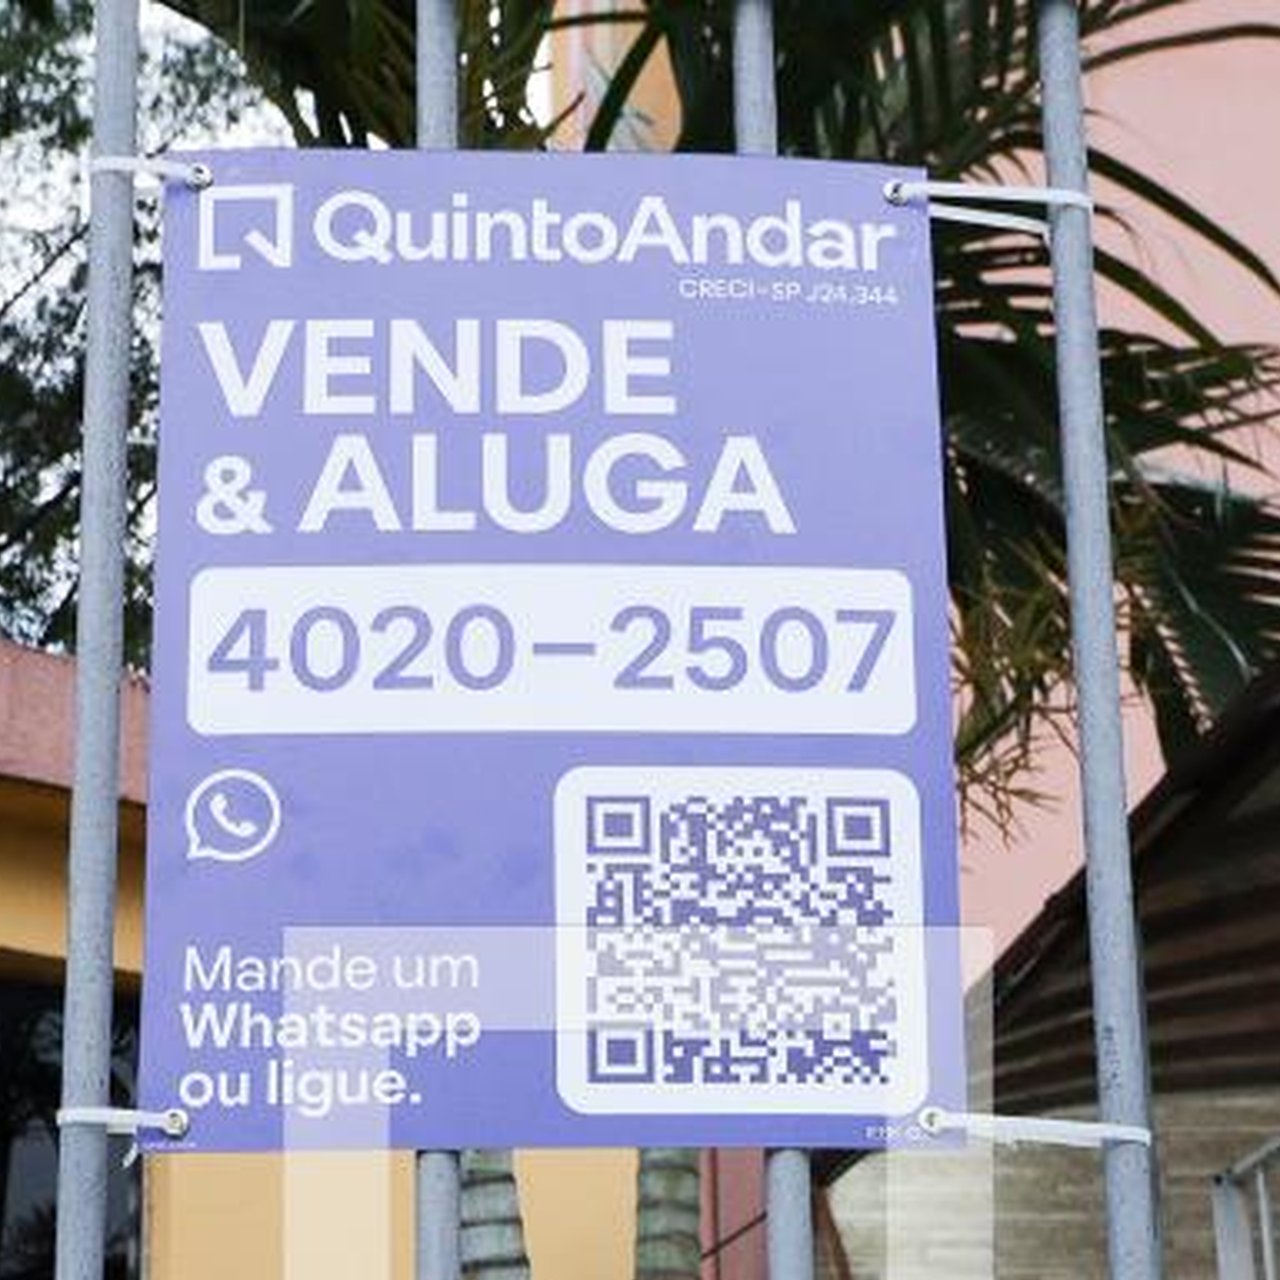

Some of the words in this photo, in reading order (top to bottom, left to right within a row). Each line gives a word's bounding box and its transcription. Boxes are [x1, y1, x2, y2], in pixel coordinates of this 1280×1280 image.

[313, 190, 898, 271] QuintoAndar
[198, 319, 678, 417] VENDE
[195, 455, 273, 535] &
[296, 432, 798, 534] ALUGA
[206, 604, 898, 694] 4020-2507
[183, 943, 377, 992] Mande
[392, 953, 480, 990] um
[179, 1002, 481, 1057] Whatsapp
[178, 1070, 251, 1108] ou
[267, 1059, 423, 1118] ligue.
